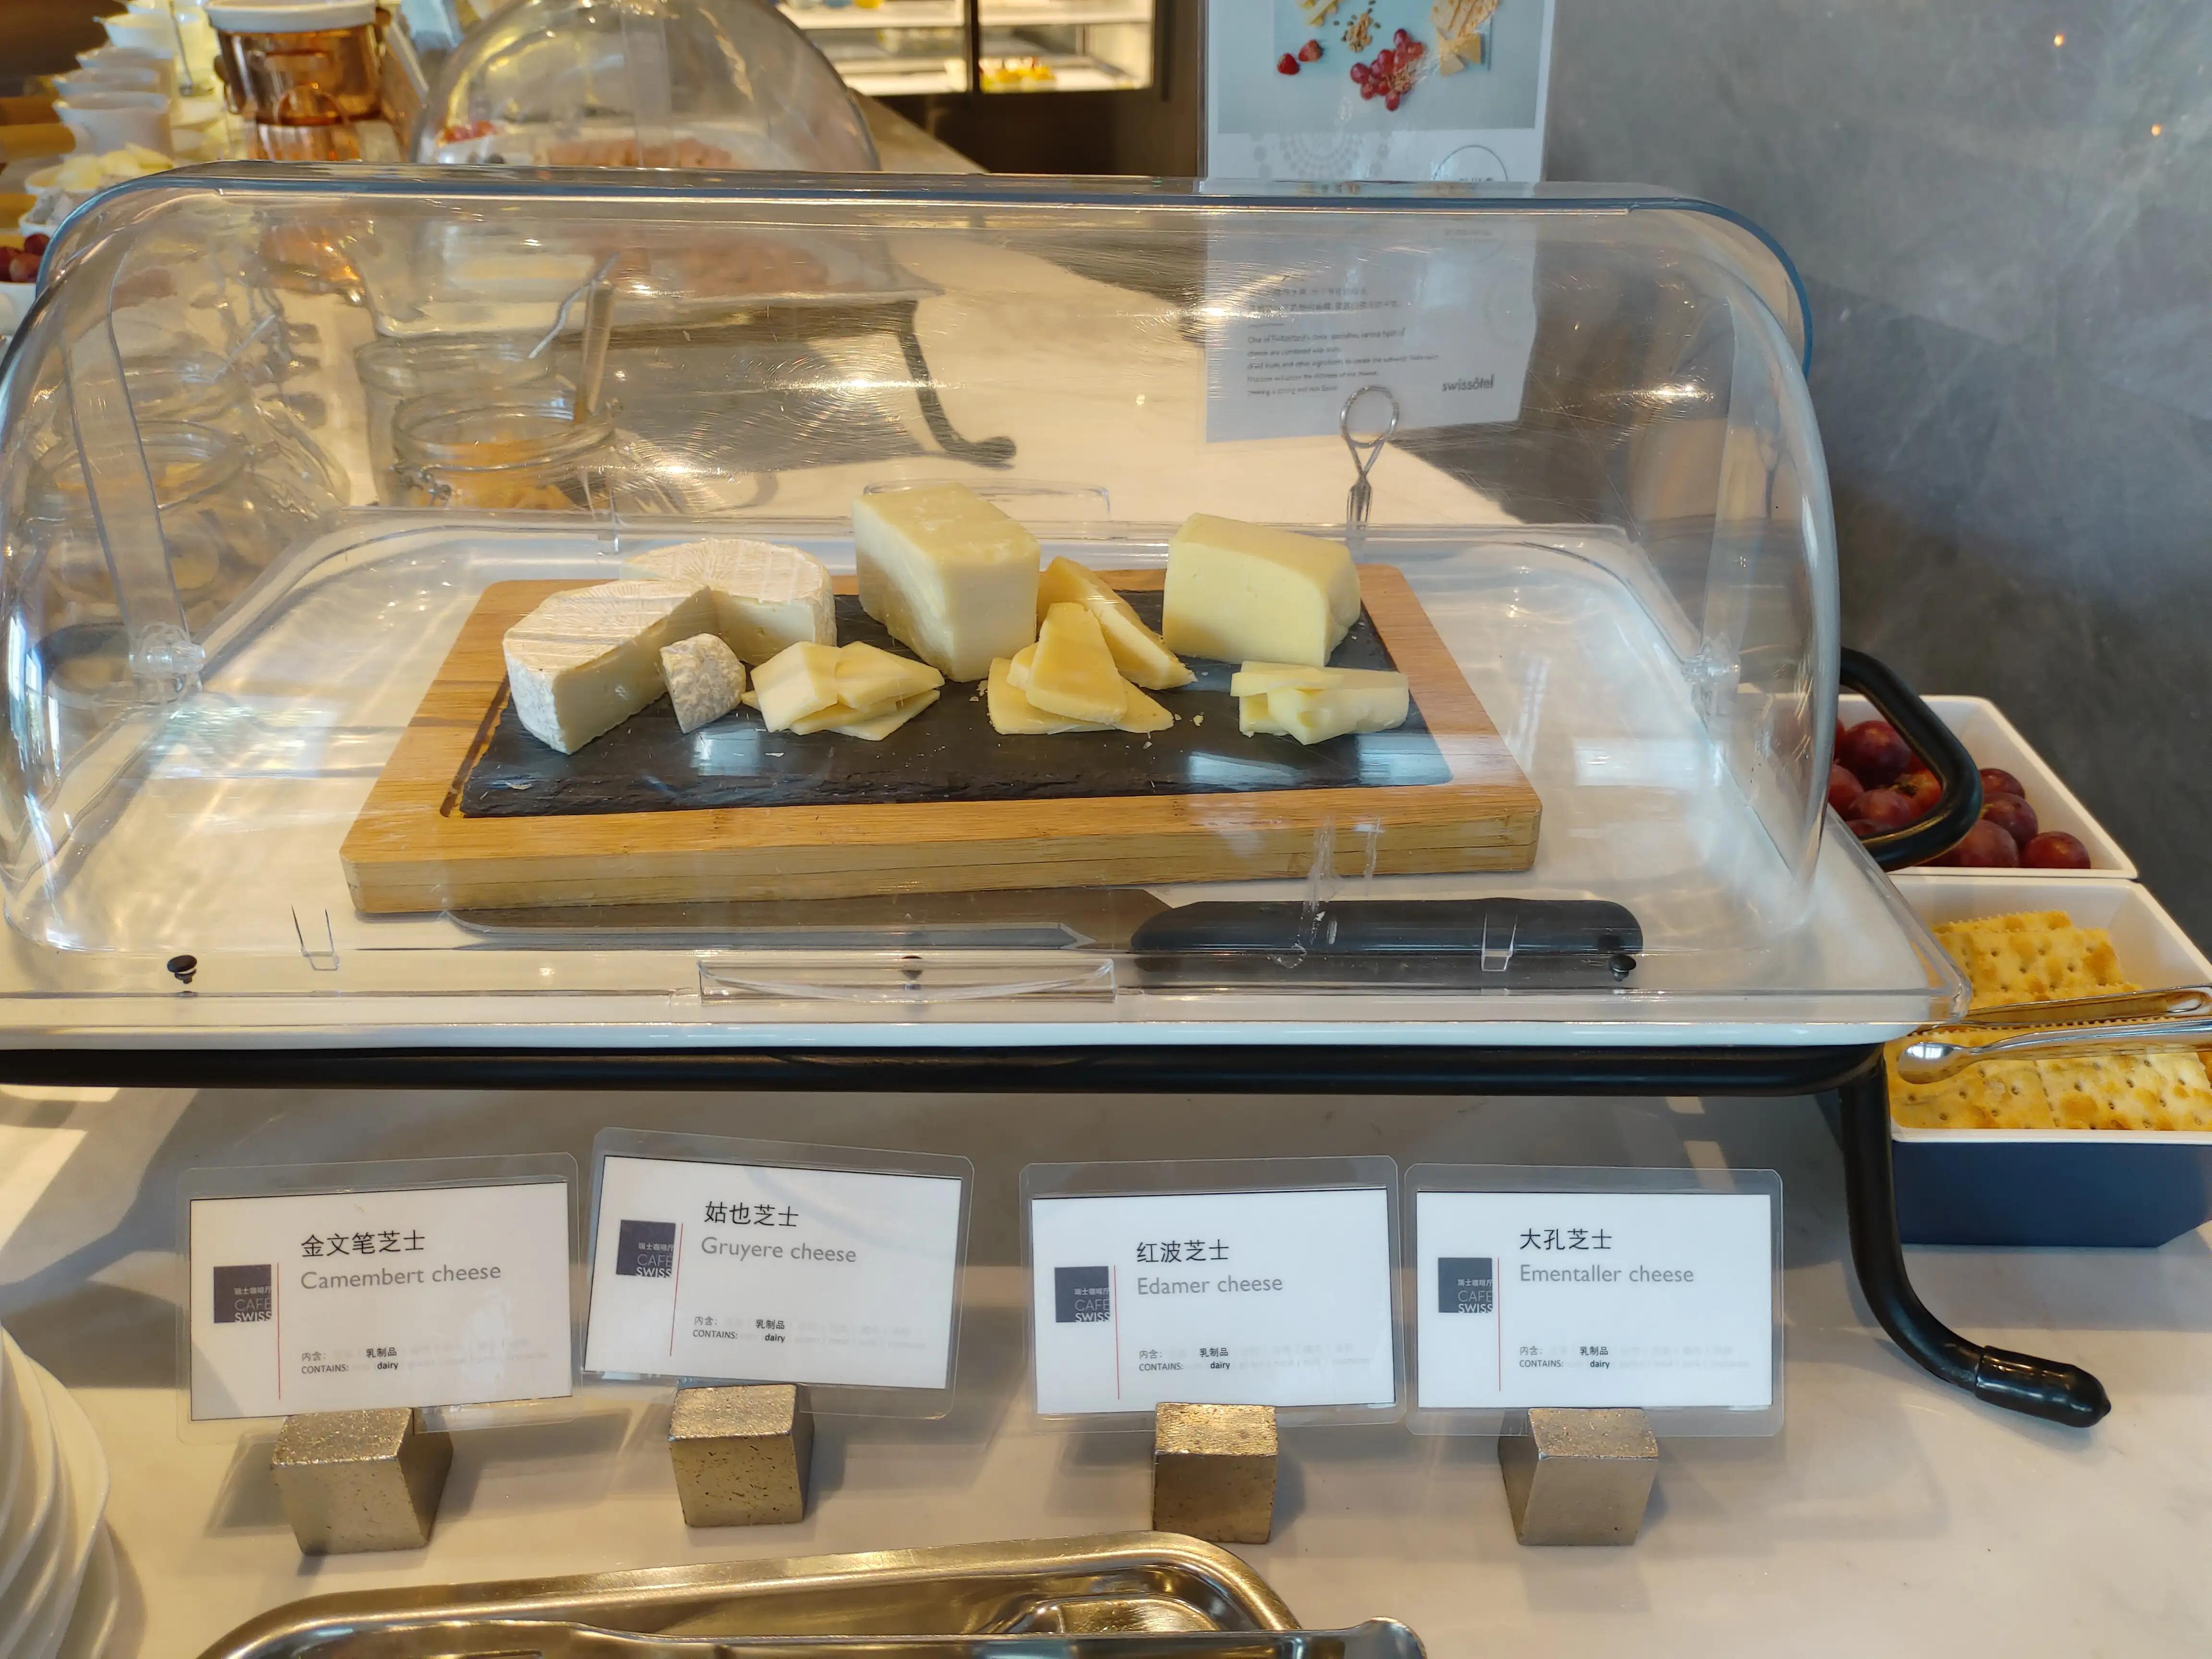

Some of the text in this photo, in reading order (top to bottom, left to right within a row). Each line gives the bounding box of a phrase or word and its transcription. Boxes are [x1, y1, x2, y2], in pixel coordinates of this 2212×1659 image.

[704, 1201, 799, 1227] 姑也芝士
[301, 1229, 425, 1257] 金文笔芝士
[1520, 1228, 1612, 1250] 大孔芝士
[701, 1237, 856, 1262] Gruyere cheese
[1136, 1239, 1229, 1263] 红波芝士
[301, 1264, 501, 1289] Camembert cheese
[636, 1266, 672, 1278] SWISS
[1520, 1264, 1694, 1282] Ementaller cheese
[1138, 1274, 1283, 1295] Edamer cheese
[1458, 1303, 1493, 1314] SWISS
[234, 1311, 272, 1323] SWISS
[1075, 1312, 1110, 1322] SWISS
[756, 1319, 785, 1330] 乳制品
[693, 1329, 738, 1339] CONTAINS:
[765, 1333, 785, 1343] dairy
[366, 1347, 397, 1358] 乳制品
[1199, 1347, 1228, 1358] 乳制品
[1580, 1346, 1609, 1356] 乳制品
[301, 1364, 349, 1374] CONTAINS:
[377, 1361, 398, 1370] dairy
[1139, 1362, 1183, 1371] CONTAINS:
[1210, 1361, 1230, 1370] dairy
[1519, 1359, 1563, 1368] CONTAINS:
[1590, 1360, 1610, 1369] dairy
